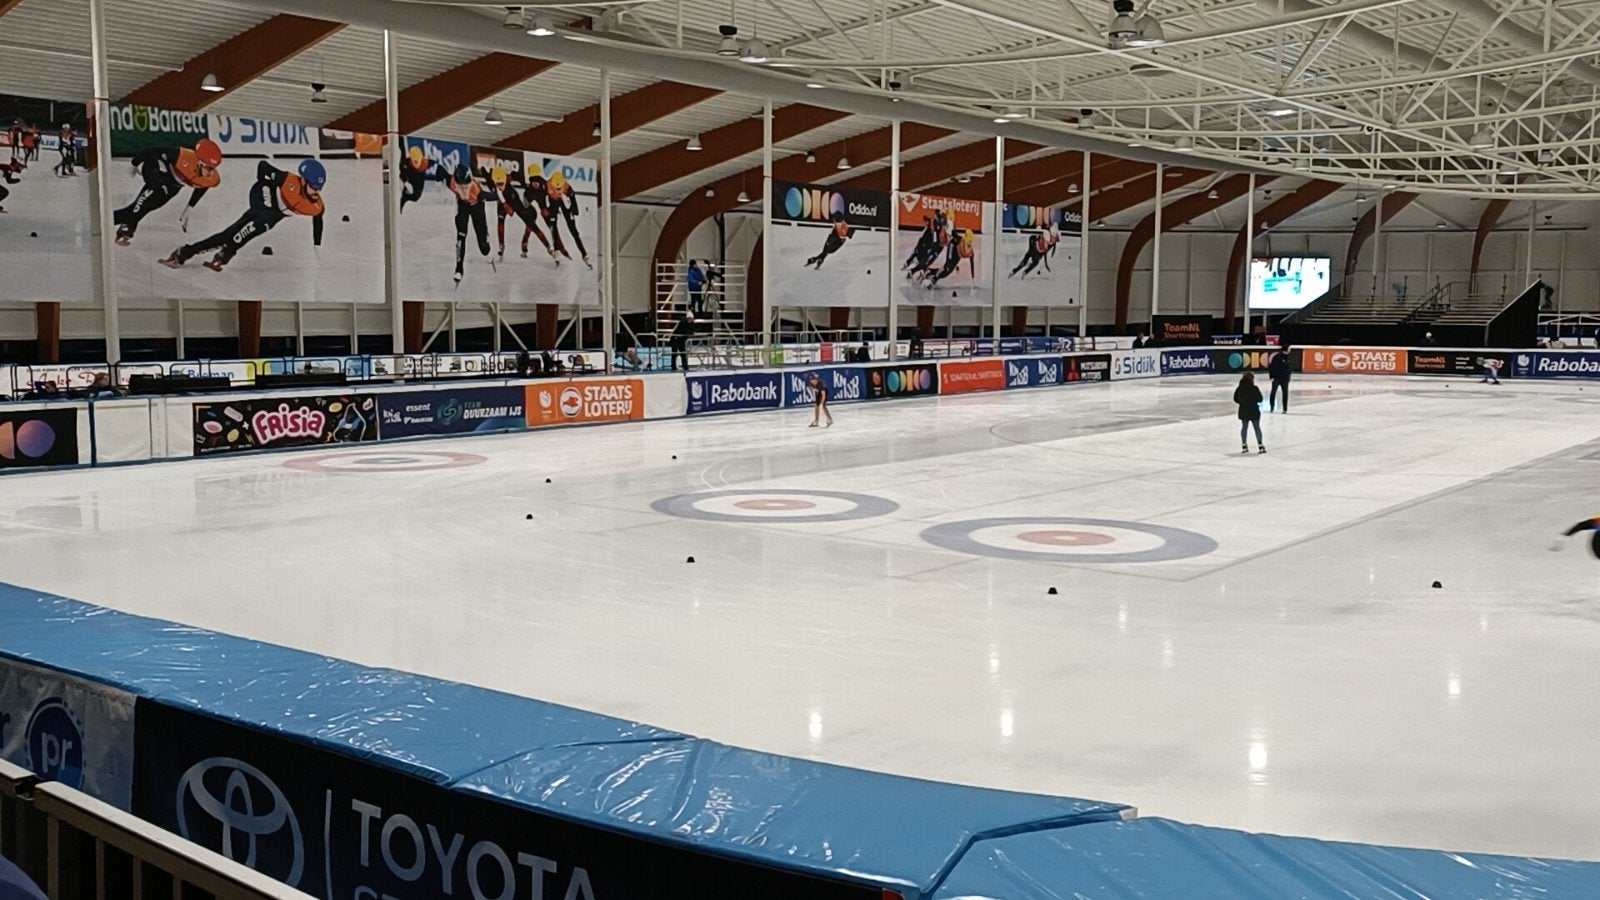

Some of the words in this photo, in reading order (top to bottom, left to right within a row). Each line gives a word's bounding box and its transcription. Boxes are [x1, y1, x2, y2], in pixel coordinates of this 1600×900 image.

[1169, 354, 1210, 369] Rabobank
[1352, 351, 1396, 361] STAATS
[1538, 357, 1600, 372] Raboba
[584, 385, 632, 402] STAATS
[711, 380, 777, 404] Rabobank
[463, 408, 508, 419] DUURZAAM
[41, 731, 73, 774] pr
